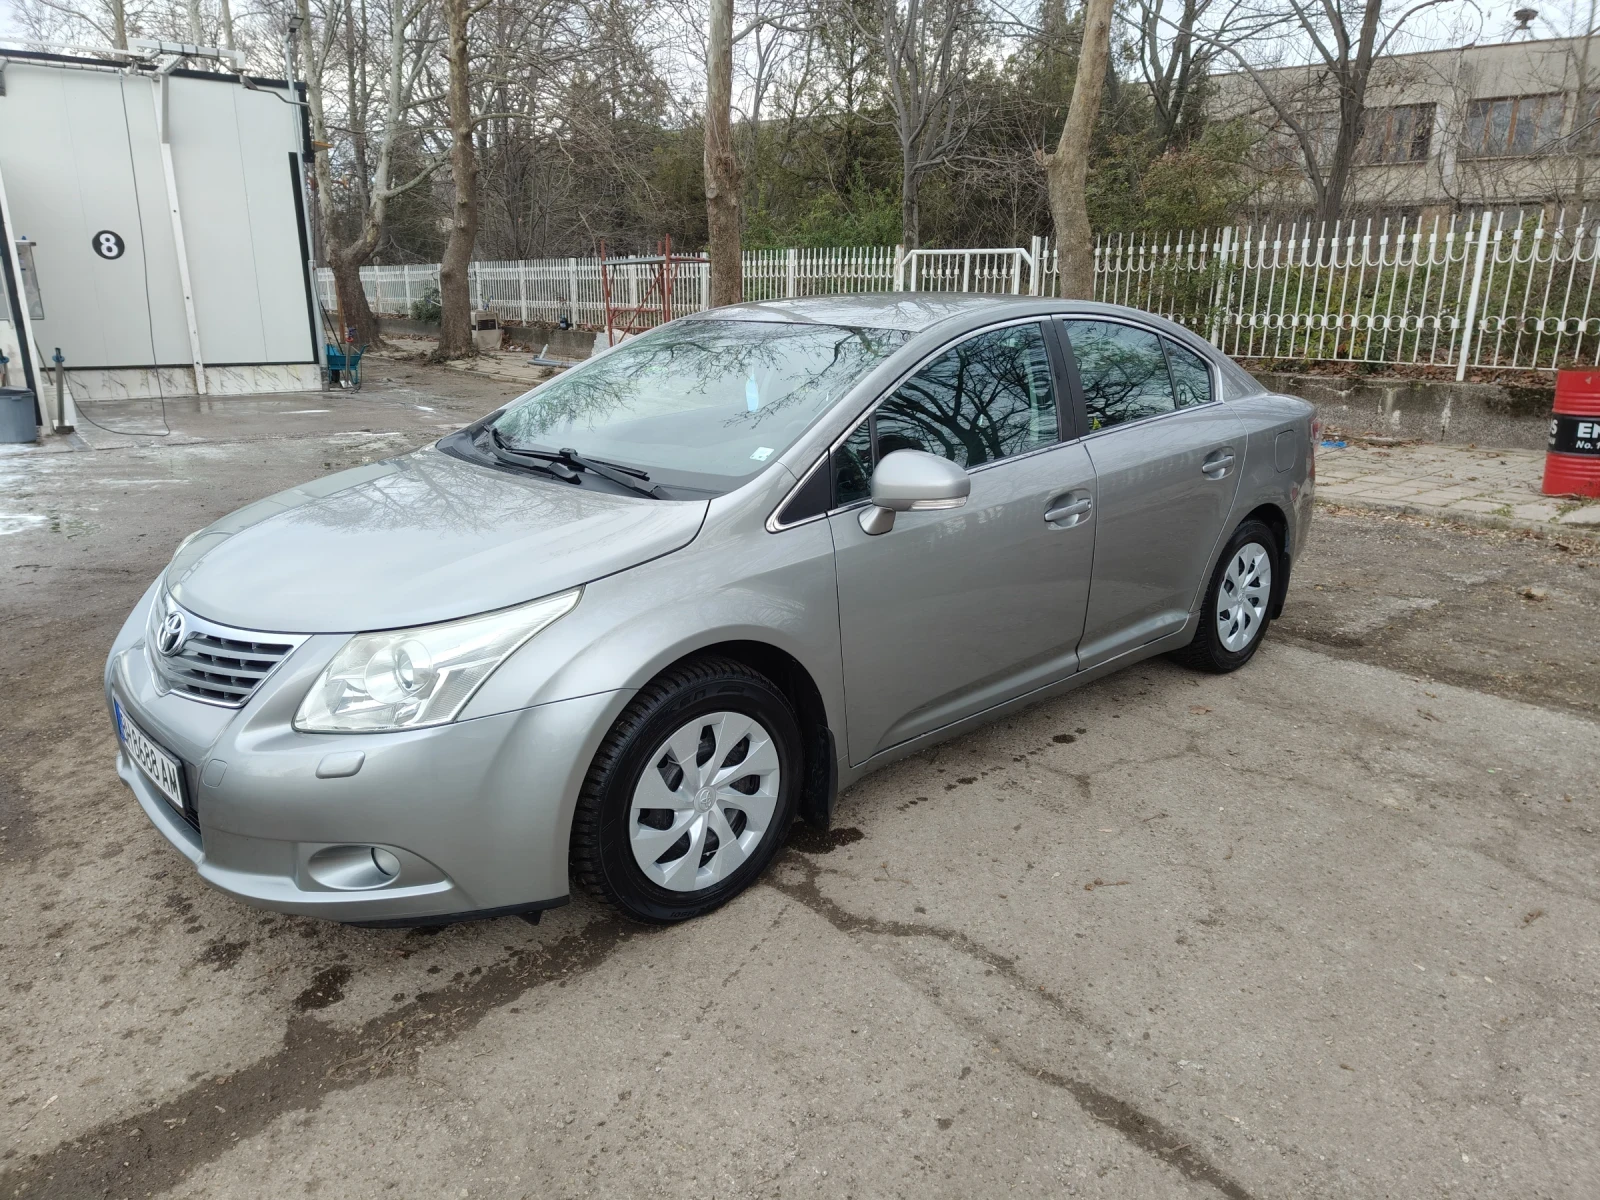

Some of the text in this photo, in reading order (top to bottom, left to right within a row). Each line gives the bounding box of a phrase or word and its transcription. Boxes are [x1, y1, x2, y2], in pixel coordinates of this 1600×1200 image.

[99, 233, 119, 257] 8
[1575, 440, 1594, 450] No.
[161, 757, 180, 801] AM
